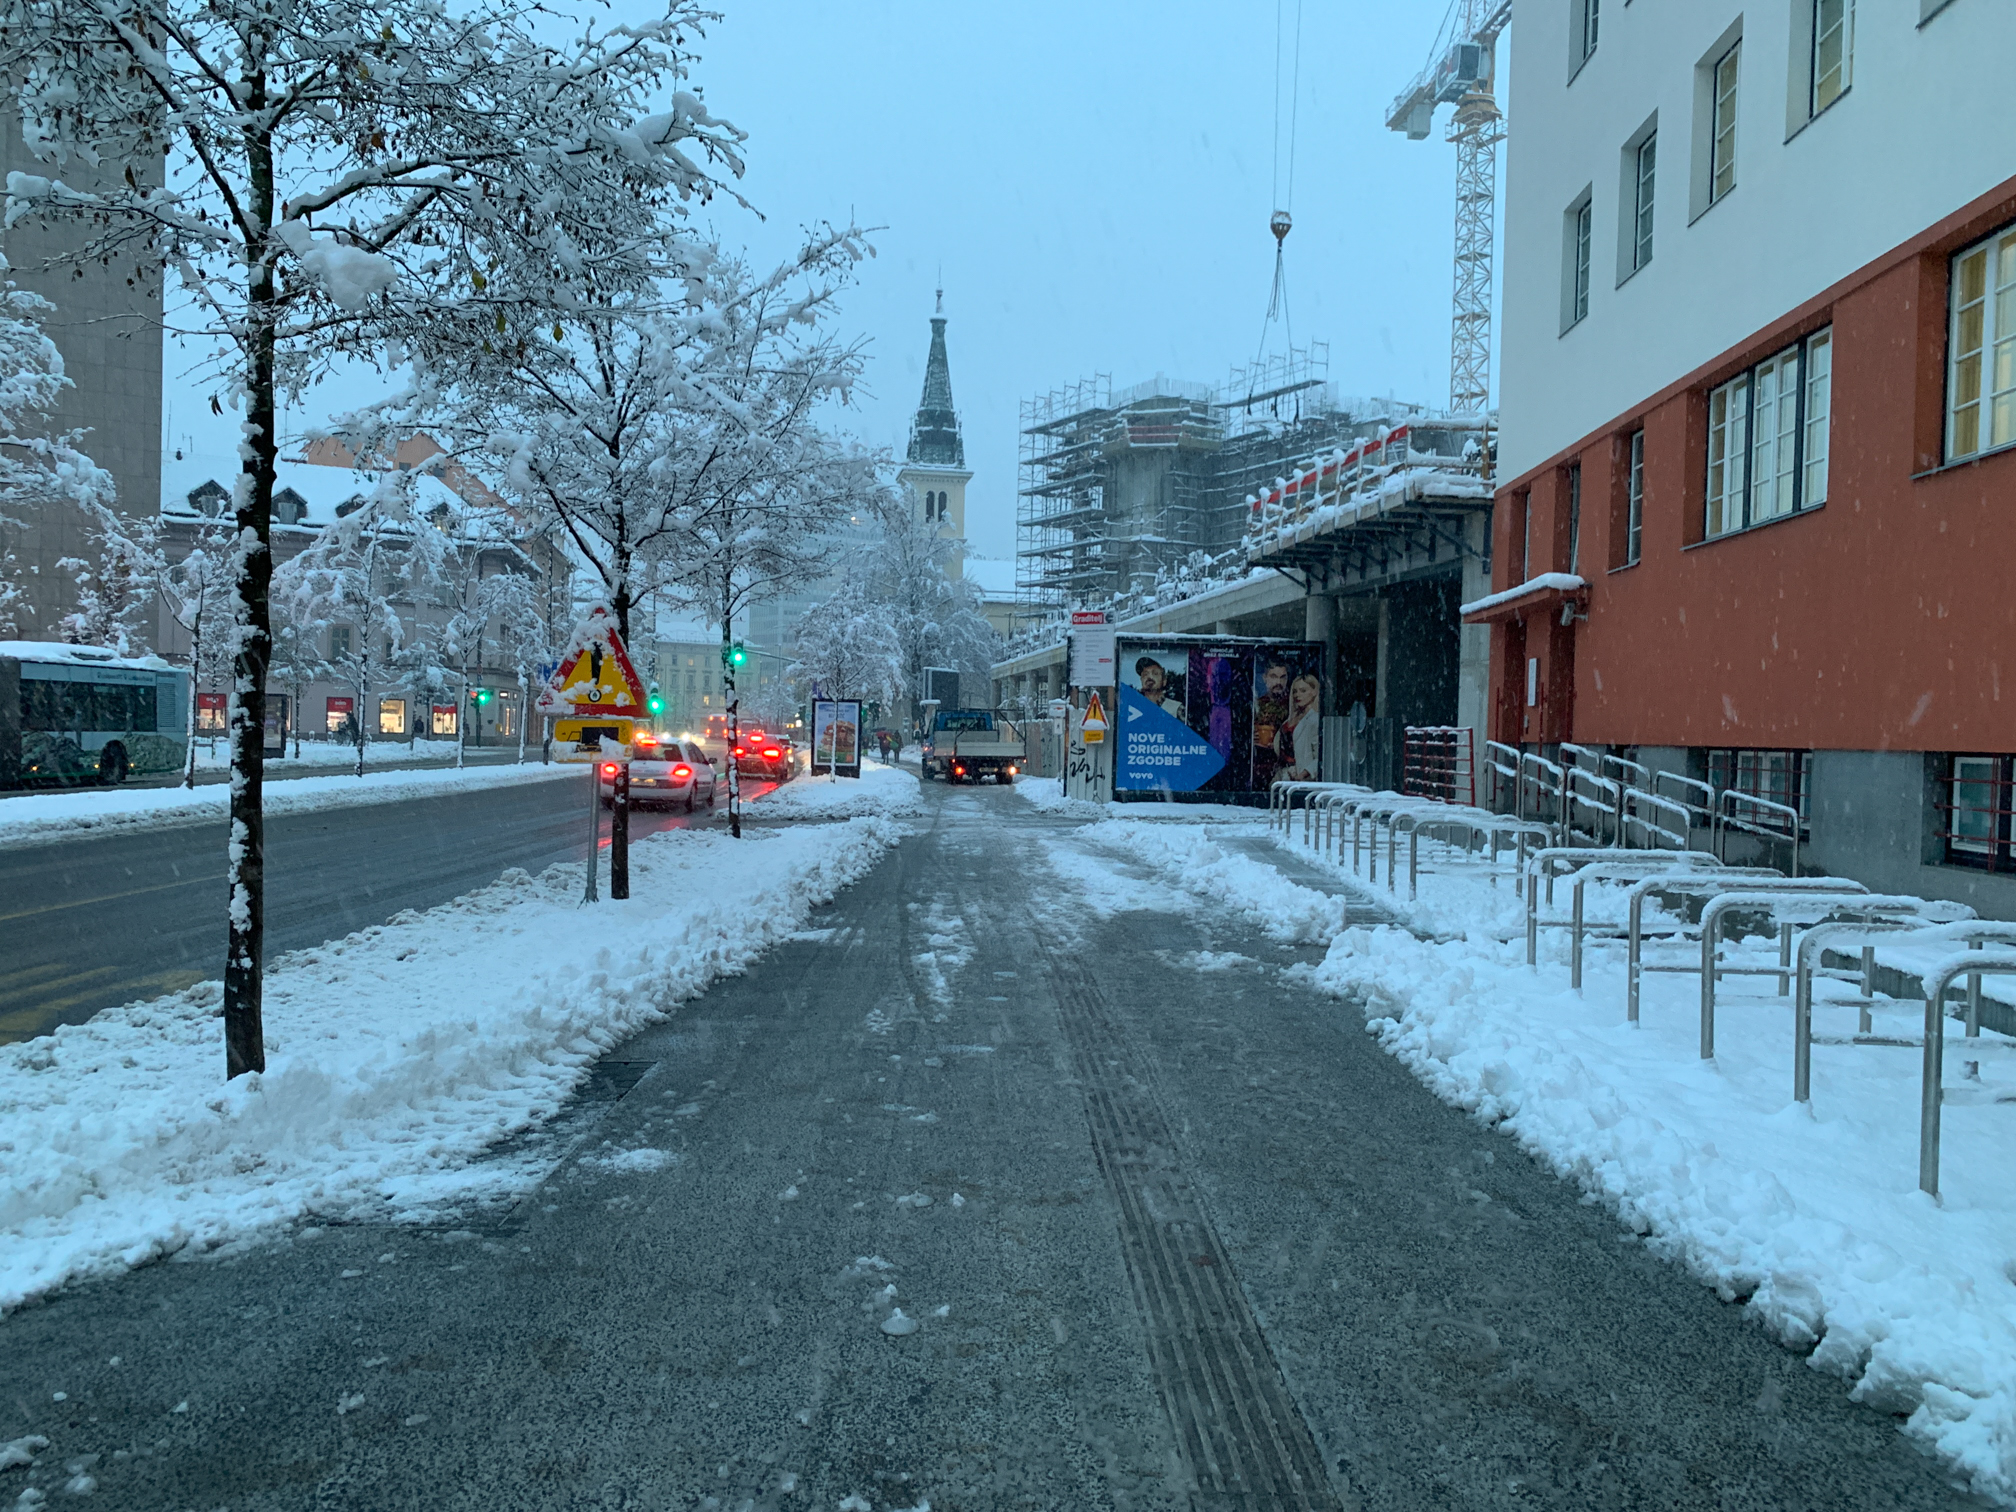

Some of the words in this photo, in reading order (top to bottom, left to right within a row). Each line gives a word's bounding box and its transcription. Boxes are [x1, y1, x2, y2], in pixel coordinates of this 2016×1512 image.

[1073, 614, 1103, 623] Graditelj
[1128, 733, 1165, 743] NOVE
[1127, 744, 1207, 755] ORIGINALNE
[1127, 755, 1182, 766] ZGODBE
